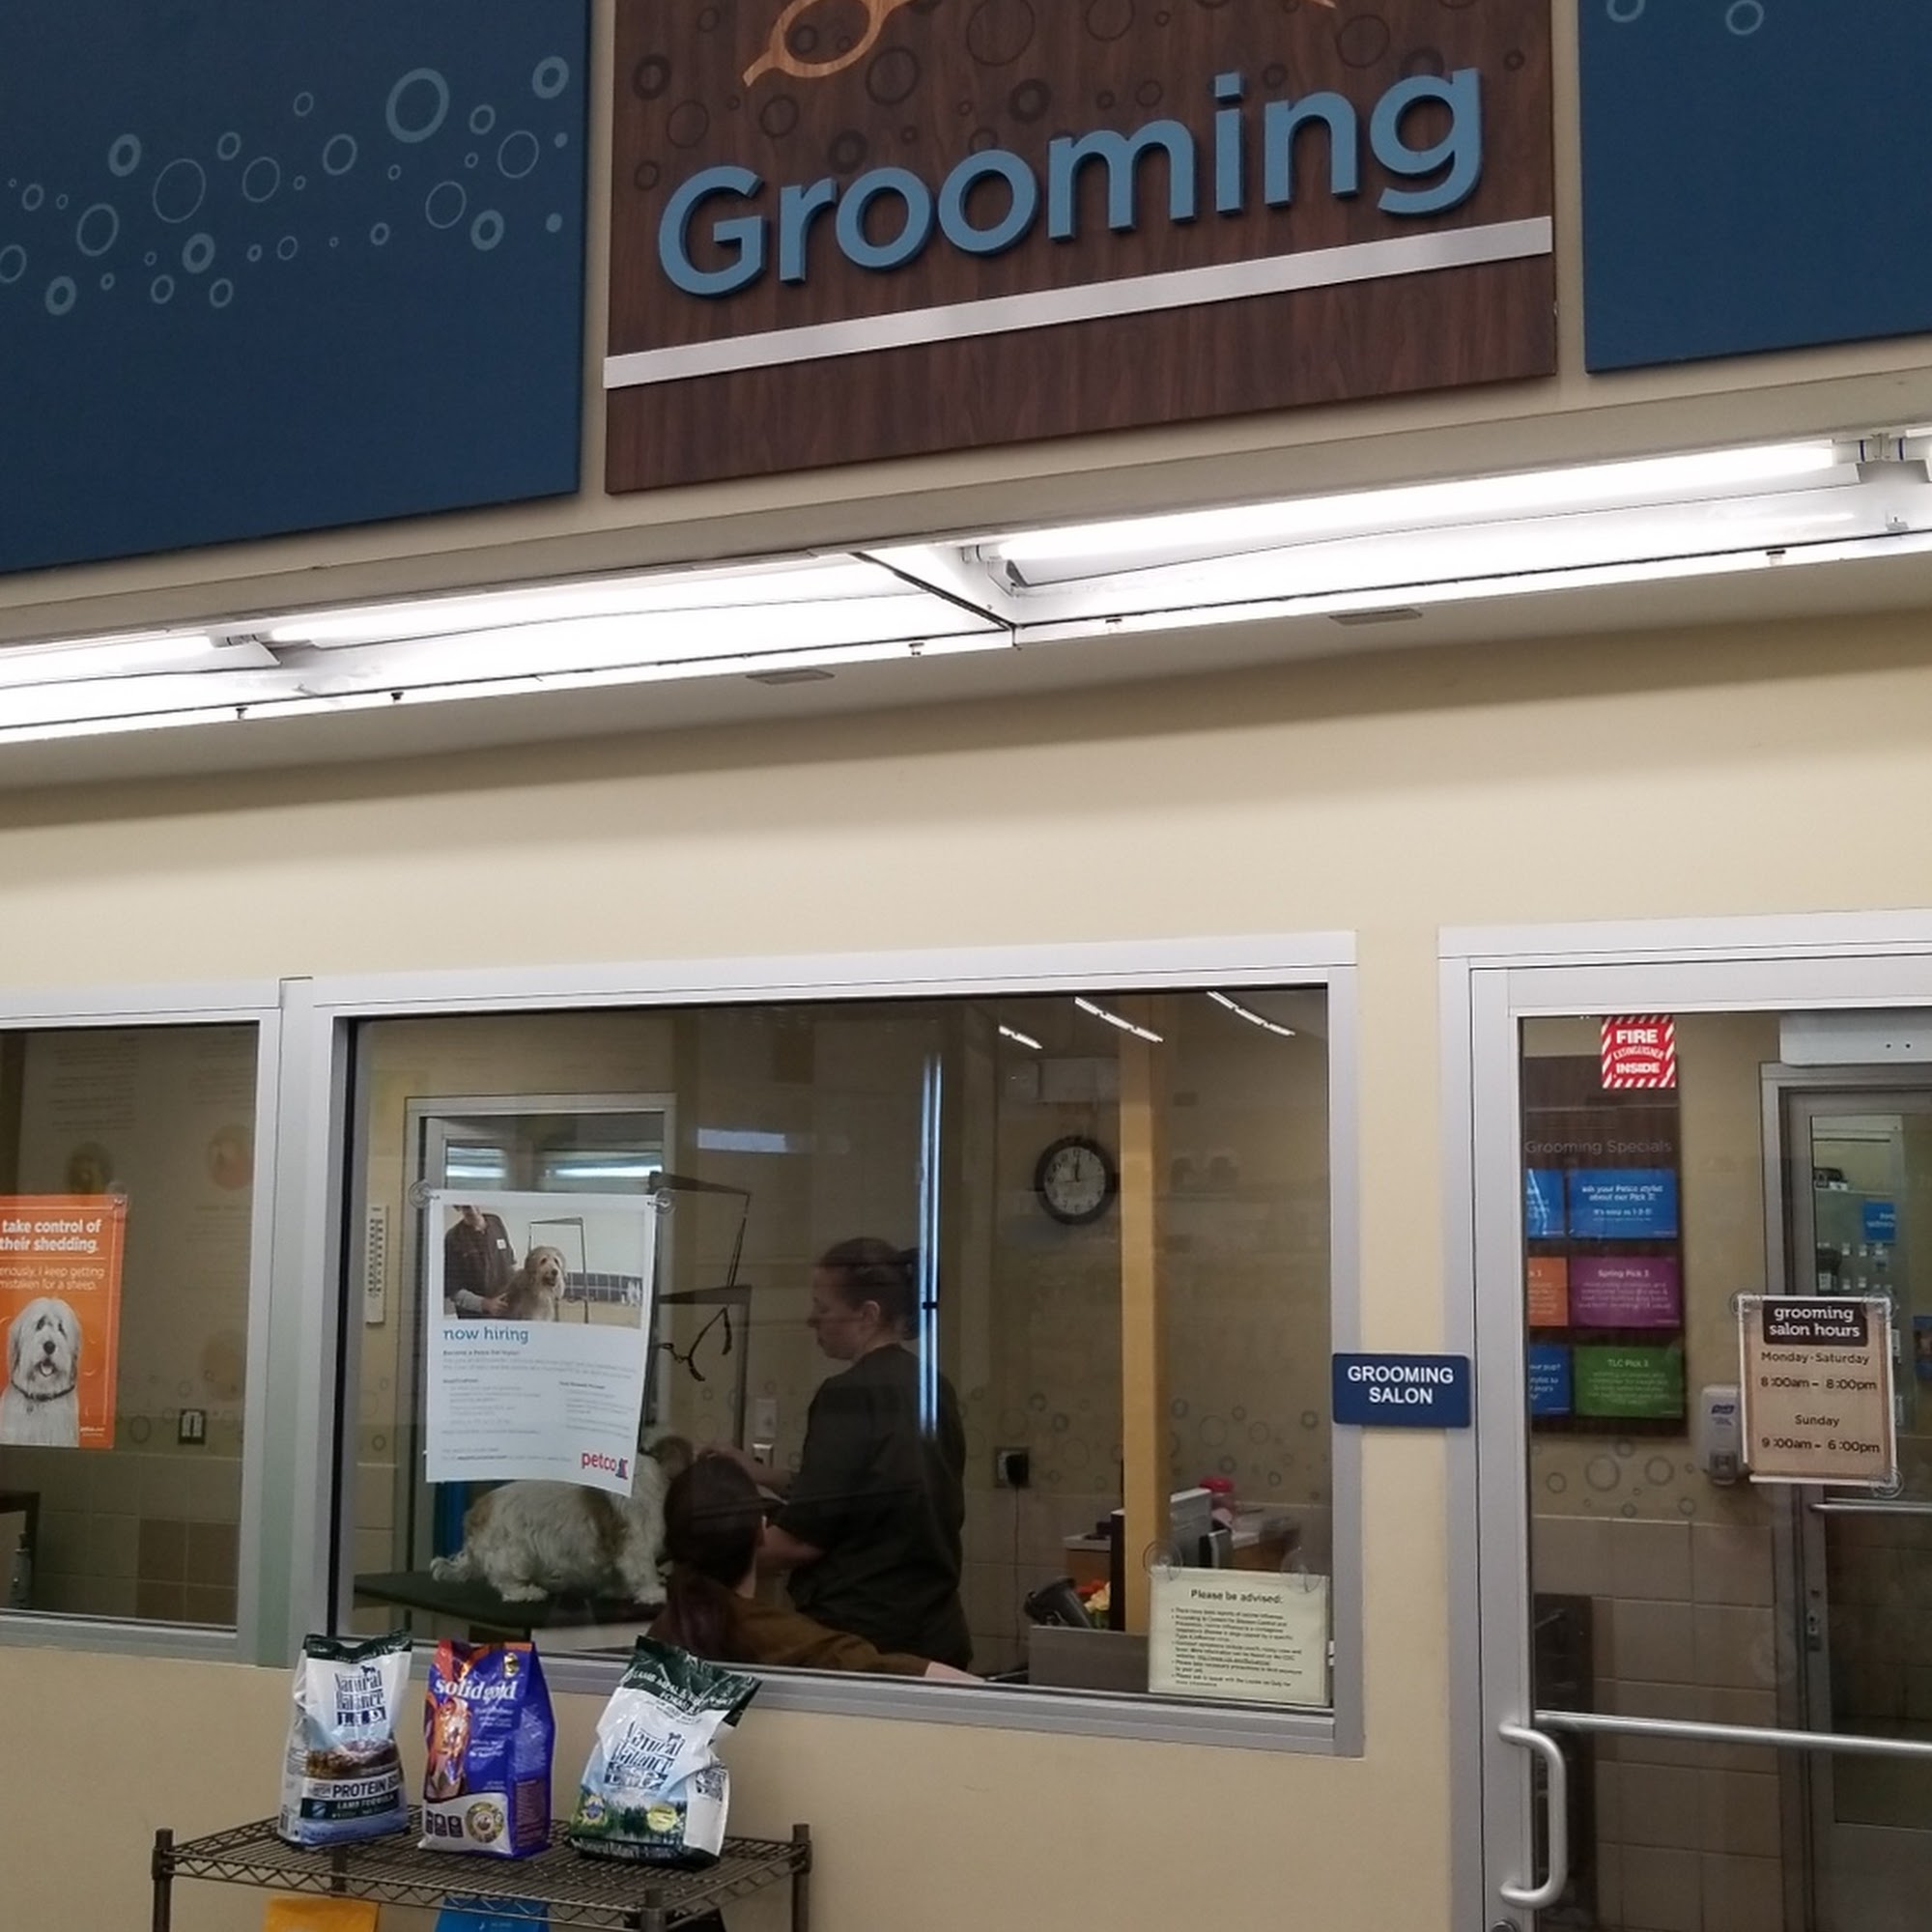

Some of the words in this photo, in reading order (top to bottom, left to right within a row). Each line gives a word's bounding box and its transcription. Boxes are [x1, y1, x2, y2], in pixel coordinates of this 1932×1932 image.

[658, 68, 1483, 297] Grooming
[1616, 1029, 1659, 1044] FIRE
[1616, 1063, 1661, 1074] INSIDE
[1524, 1140, 1603, 1155] Grooming
[1606, 1139, 1672, 1155] Specials
[3, 1218, 32, 1233] take
[34, 1218, 83, 1233] control
[86, 1218, 102, 1233] of
[0, 1236, 30, 1251] their
[33, 1236, 99, 1254] shedding.
[1598, 1270, 1624, 1279] Spring
[1774, 1308, 1854, 1322] grooming
[443, 1328, 480, 1342] now
[483, 1326, 529, 1345] hiring
[1769, 1323, 1810, 1337] salon
[1814, 1323, 1861, 1338] hours
[1348, 1366, 1454, 1383] GROOMING
[1369, 1386, 1433, 1404] SALON
[1795, 1414, 1840, 1428] Sunday
[582, 1452, 617, 1471] petco
[1190, 1589, 1223, 1600] Please
[1225, 1590, 1236, 1601] be
[1240, 1593, 1283, 1605] advised:
[435, 1678, 485, 1699] solid
[483, 1681, 519, 1706] gold
[332, 1778, 387, 1798] PROTEIN
